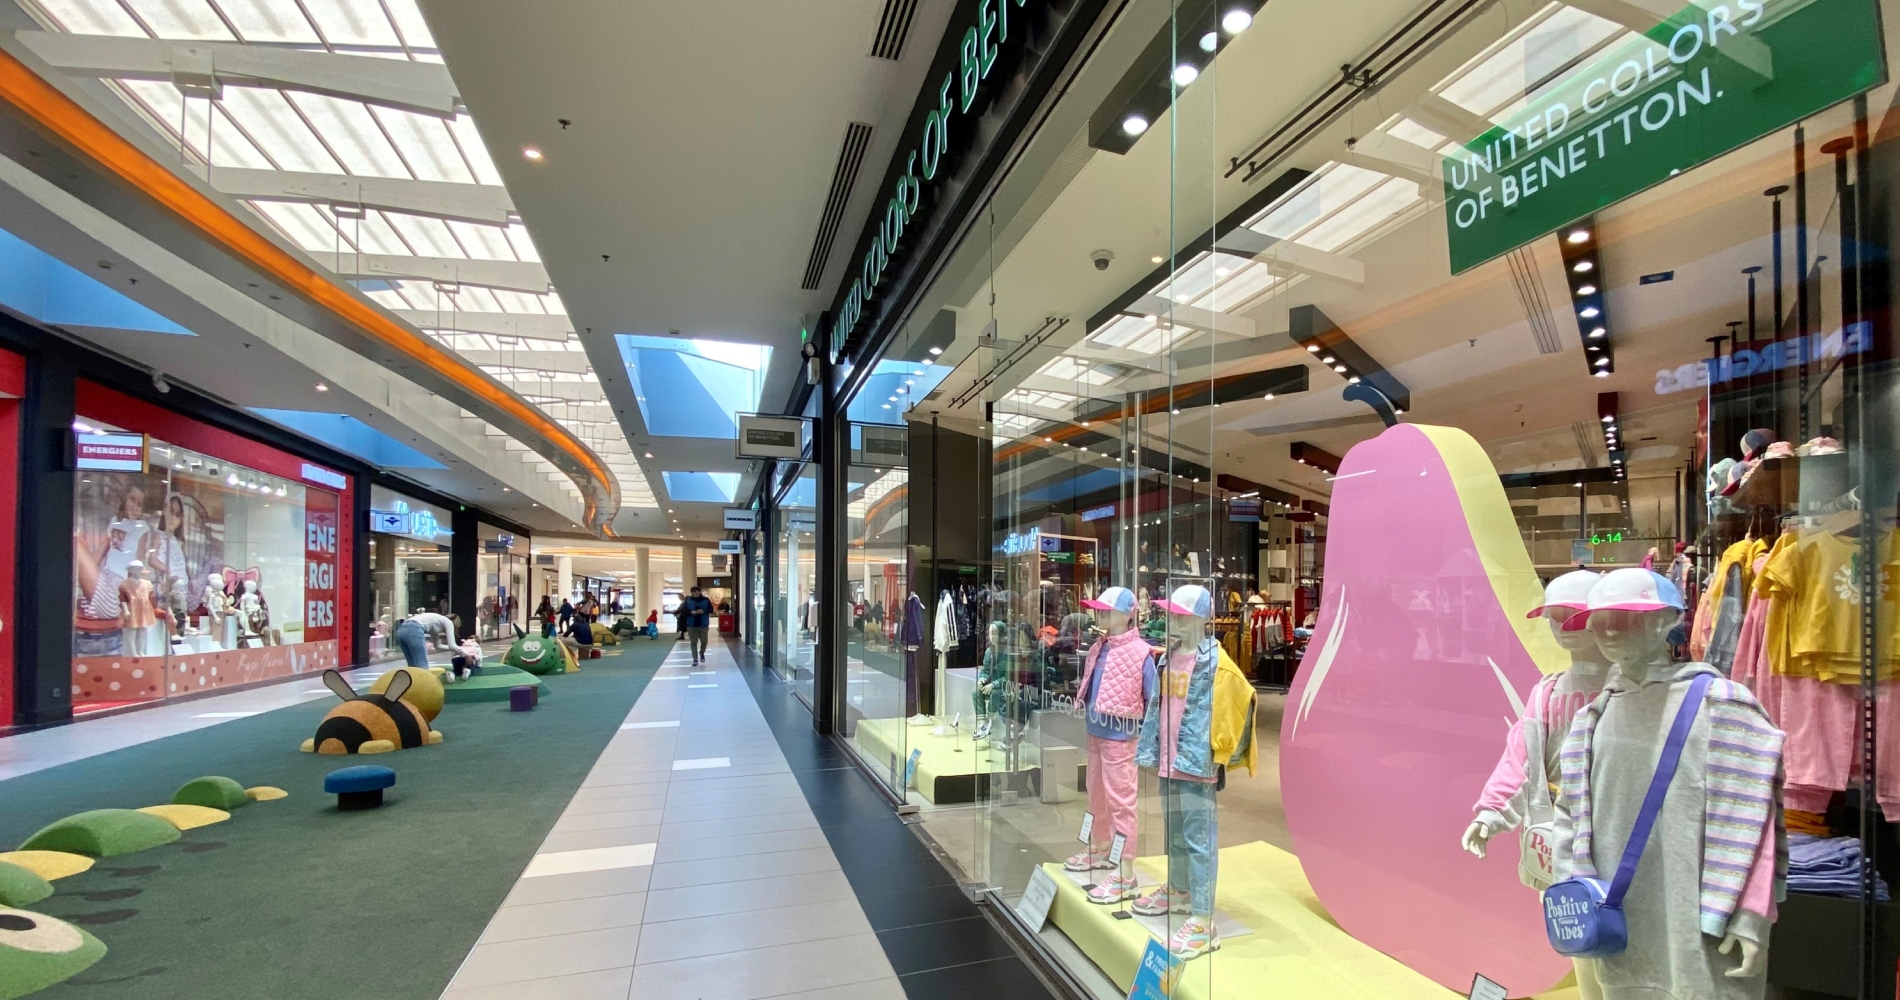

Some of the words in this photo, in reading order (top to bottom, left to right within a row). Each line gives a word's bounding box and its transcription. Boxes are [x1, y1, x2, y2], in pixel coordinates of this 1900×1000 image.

[1451, 103, 1570, 191] UNITED
[1582, 0, 1764, 115] COLORS
[1454, 187, 1493, 228] OF
[1501, 66, 1724, 208] BENETTON.
[830, 278, 861, 365] UNITED
[863, 150, 919, 299] COLORS
[922, 71, 953, 180] OF
[82, 445, 138, 456] ENERGIERS
[308, 523, 335, 553] ENE
[1591, 532, 1622, 546] 6-14
[309, 562, 333, 590] RGI
[308, 600, 333, 628] ERS
[1058, 693, 1087, 720] COLD
[1545, 896, 1589, 918] Positive
[1155, 955, 1178, 977] FRIEDS
